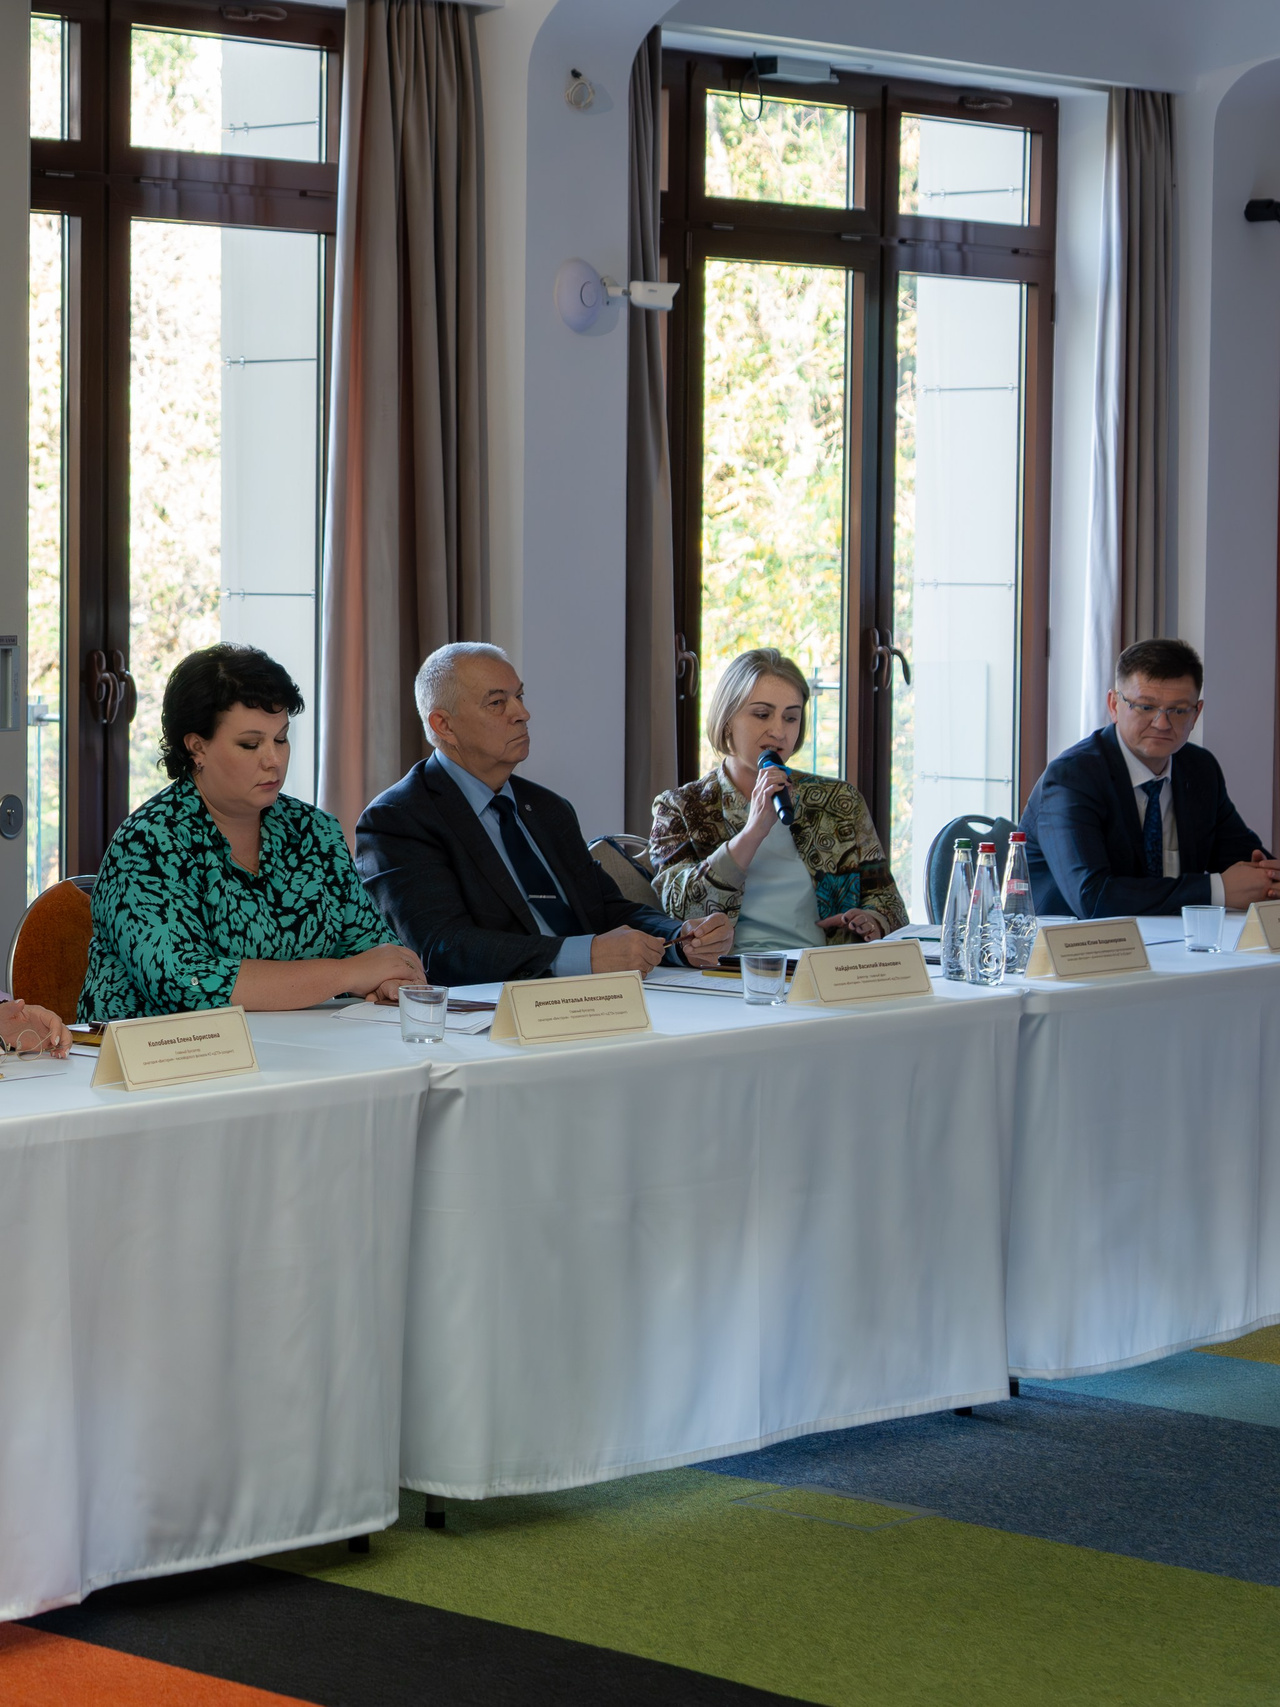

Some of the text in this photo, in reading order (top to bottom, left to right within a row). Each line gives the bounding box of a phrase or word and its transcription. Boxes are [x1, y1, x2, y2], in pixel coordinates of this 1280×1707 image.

[859, 962, 879, 970] Василий
[879, 960, 901, 968] Иванович
[535, 1000, 561, 1008] Денисова
[584, 993, 623, 1002] Александровна
[148, 1032, 220, 1048] Колобаева Елена Борисовна
